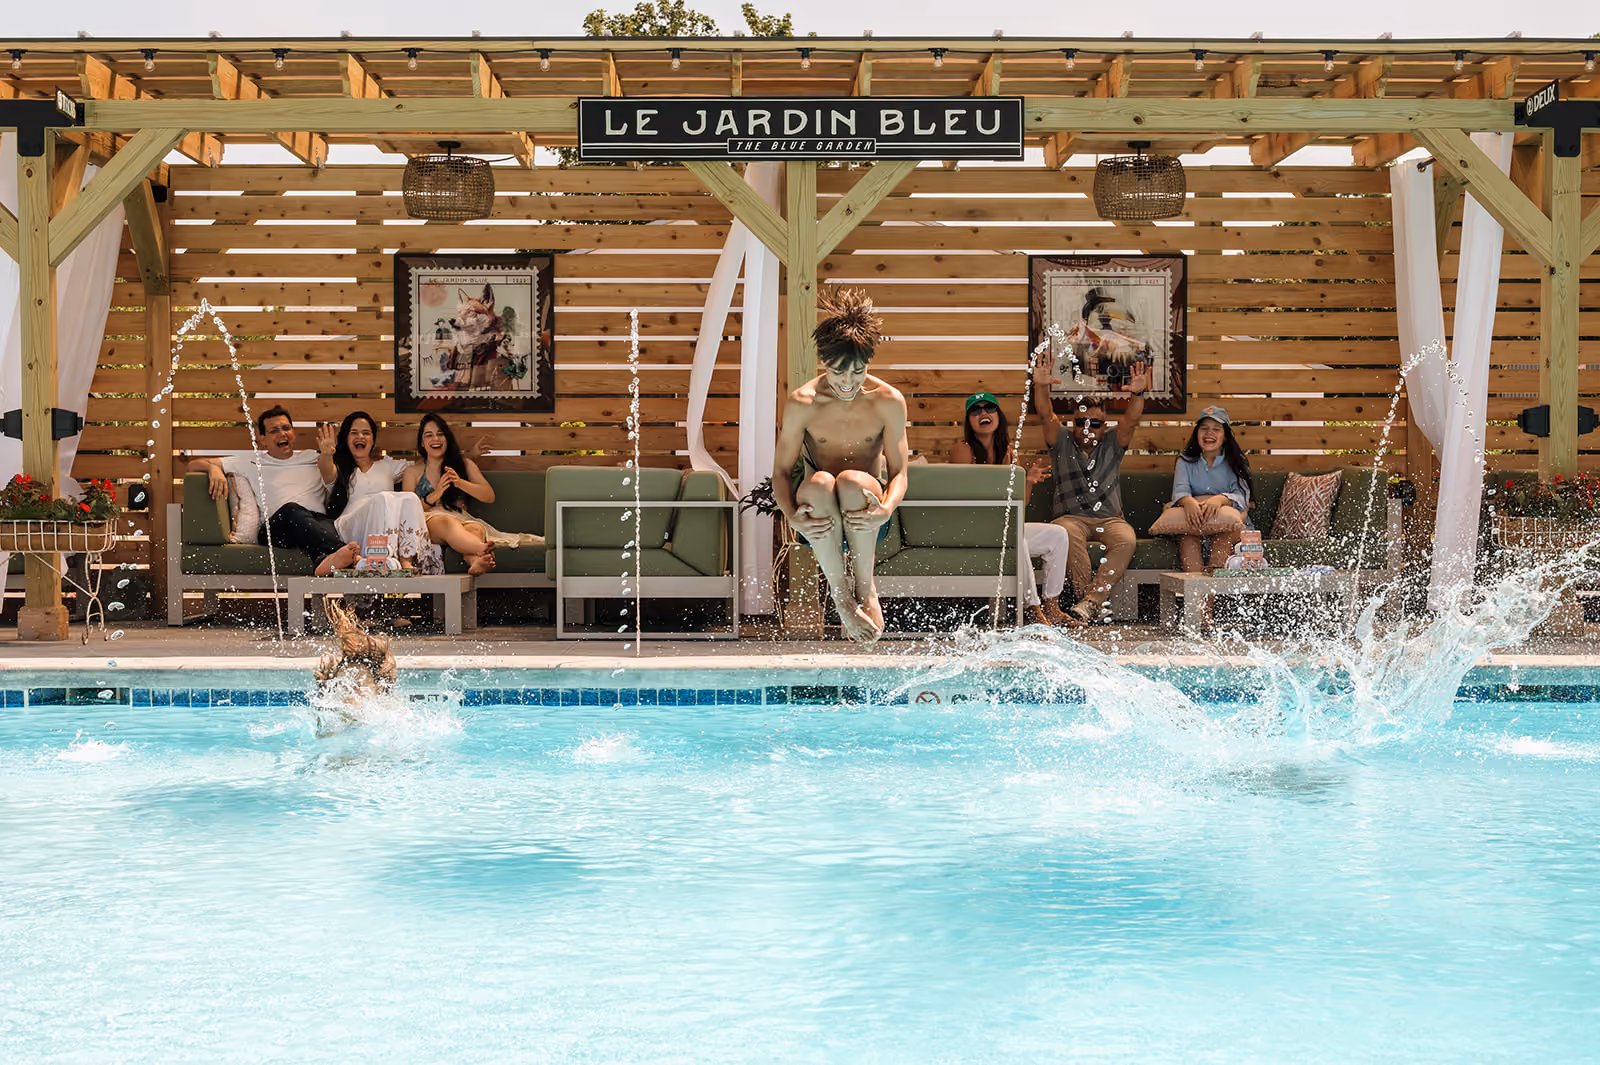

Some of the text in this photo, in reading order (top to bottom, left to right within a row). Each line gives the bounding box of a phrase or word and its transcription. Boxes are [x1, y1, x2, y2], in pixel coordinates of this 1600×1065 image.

[1534, 84, 1556, 112] DEUX
[604, 109, 1001, 136] LE JARDIN BLEU
[736, 141, 873, 151] THE BLUE GARDEN
